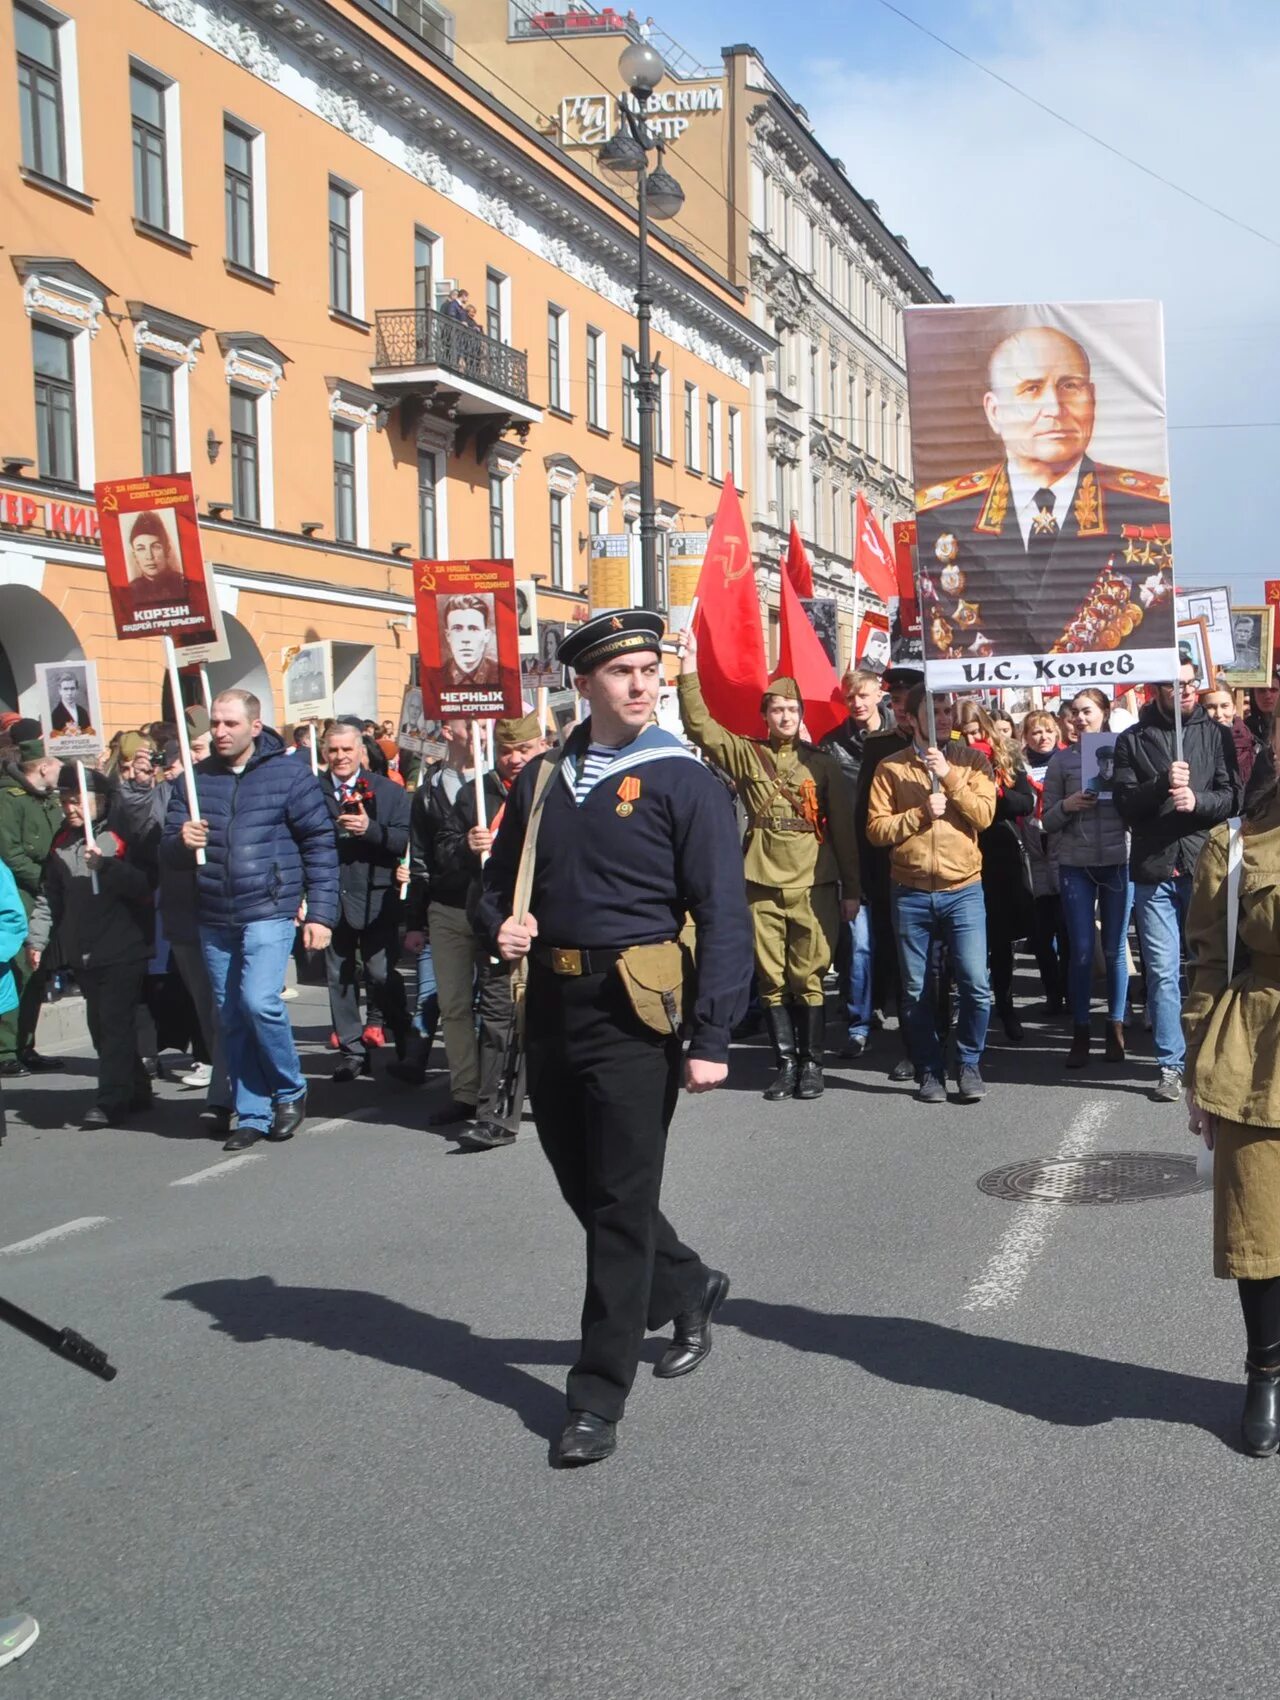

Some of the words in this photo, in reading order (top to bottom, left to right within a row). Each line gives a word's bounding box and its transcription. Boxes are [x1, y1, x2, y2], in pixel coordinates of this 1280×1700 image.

[618, 86, 723, 114] НВСКИЙ
[0, 494, 37, 525] ЕР
[133, 605, 190, 621] КОРЗУН
[962, 661, 1019, 683] И.С.
[1033, 653, 1135, 680] Конев
[440, 691, 504, 702] ЧЕРНЫХ
